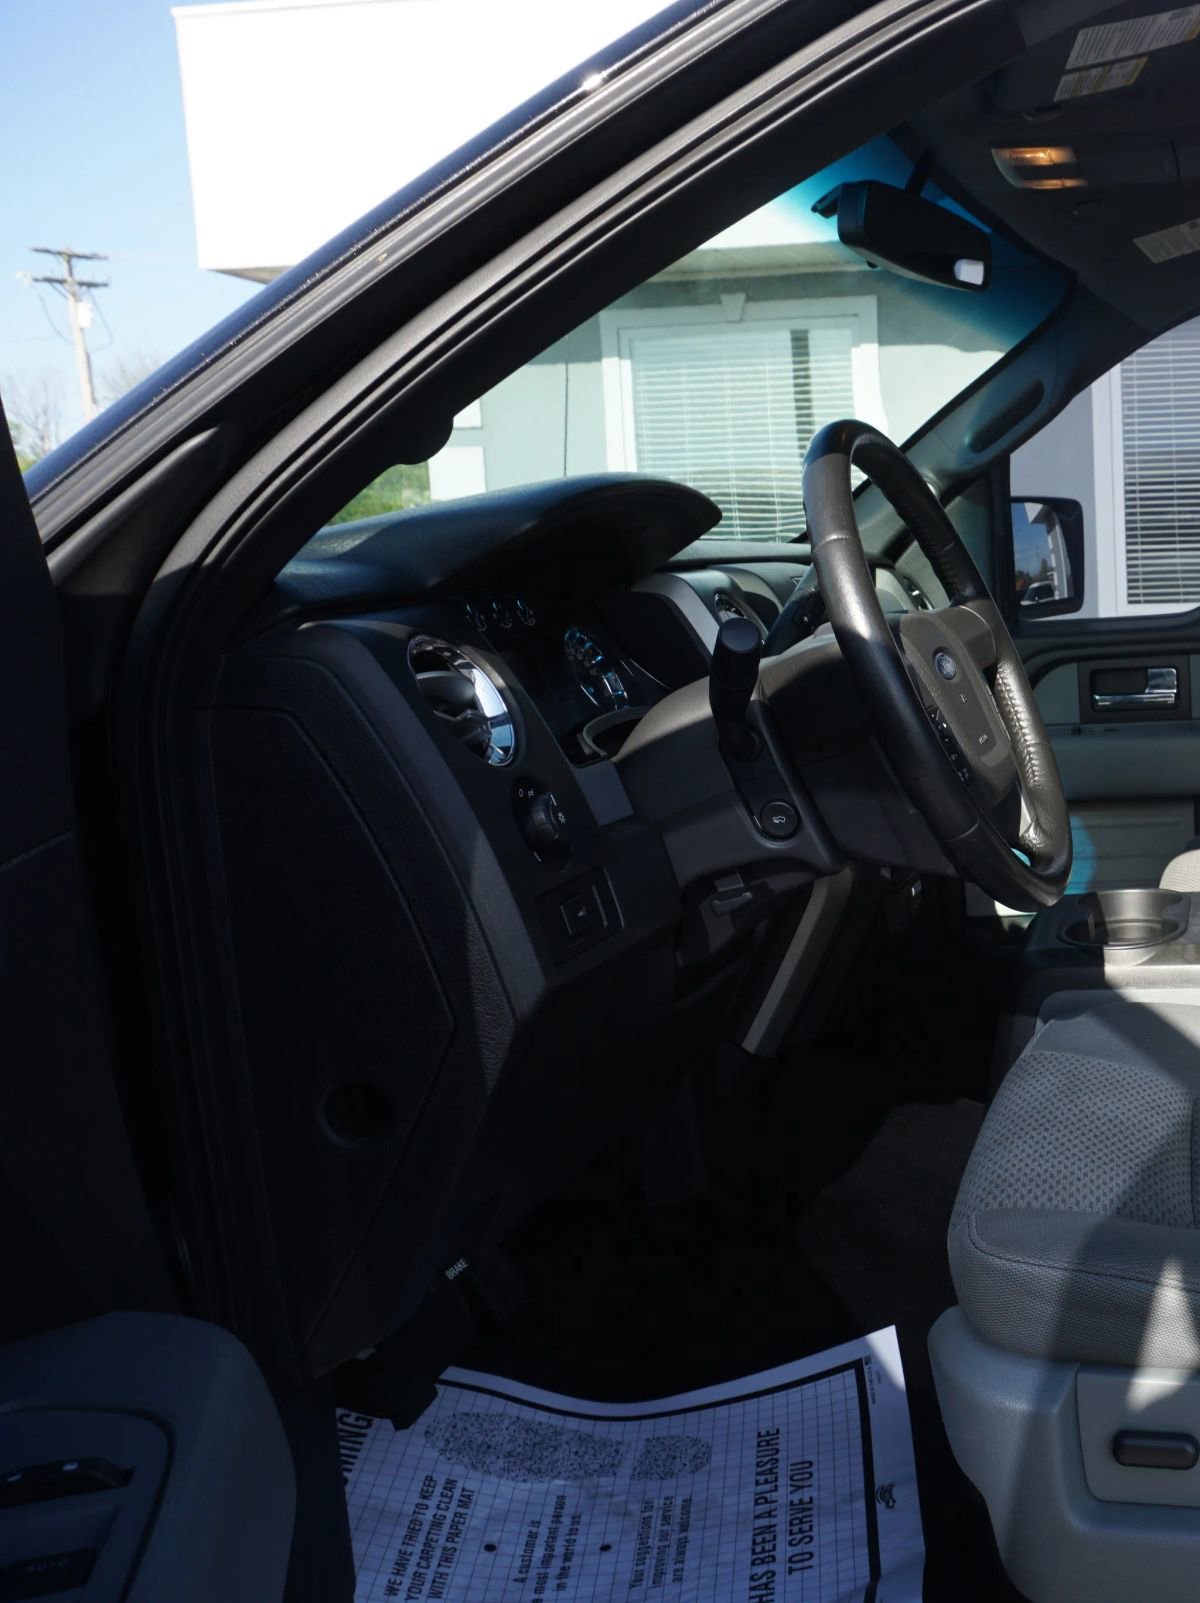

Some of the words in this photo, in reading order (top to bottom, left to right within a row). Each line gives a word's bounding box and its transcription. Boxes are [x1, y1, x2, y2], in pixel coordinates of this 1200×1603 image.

[754, 1428, 780, 1507] PLEASURE
[789, 1460, 814, 1495] YOU
[419, 1475, 437, 1500] KEEP
[457, 1487, 475, 1509] MAT
[412, 1503, 429, 1516] TO
[550, 1495, 566, 1524] person
[640, 1501, 654, 1512] for
[753, 1508, 778, 1521] A
[401, 1518, 423, 1547] TRIED
[445, 1512, 468, 1544] PAPER
[528, 1520, 541, 1528] is
[565, 1527, 579, 1536] to
[788, 1496, 814, 1546] SERVE
[404, 1571, 427, 1600] YOUR
[416, 1513, 447, 1569] CARPETING
[436, 1478, 458, 1511] CLEAN
[518, 1530, 539, 1574] customer
[537, 1527, 559, 1569] important
[562, 1538, 576, 1563] world
[634, 1515, 653, 1567] suggestions
[649, 1544, 670, 1588] improving
[660, 1495, 673, 1527] service
[672, 1536, 689, 1565] always
[751, 1524, 777, 1567] BEEN
[391, 1549, 413, 1576] HAVE
[437, 1546, 457, 1568] THIS
[788, 1551, 814, 1576] TO
[427, 1571, 449, 1599] WITH
[534, 1572, 549, 1595] most
[556, 1565, 570, 1580] the
[629, 1569, 645, 1590] Your
[672, 1567, 684, 1583] are
[384, 1578, 403, 1596] WE
[552, 1582, 567, 1591] in
[749, 1570, 776, 1603] HAS
